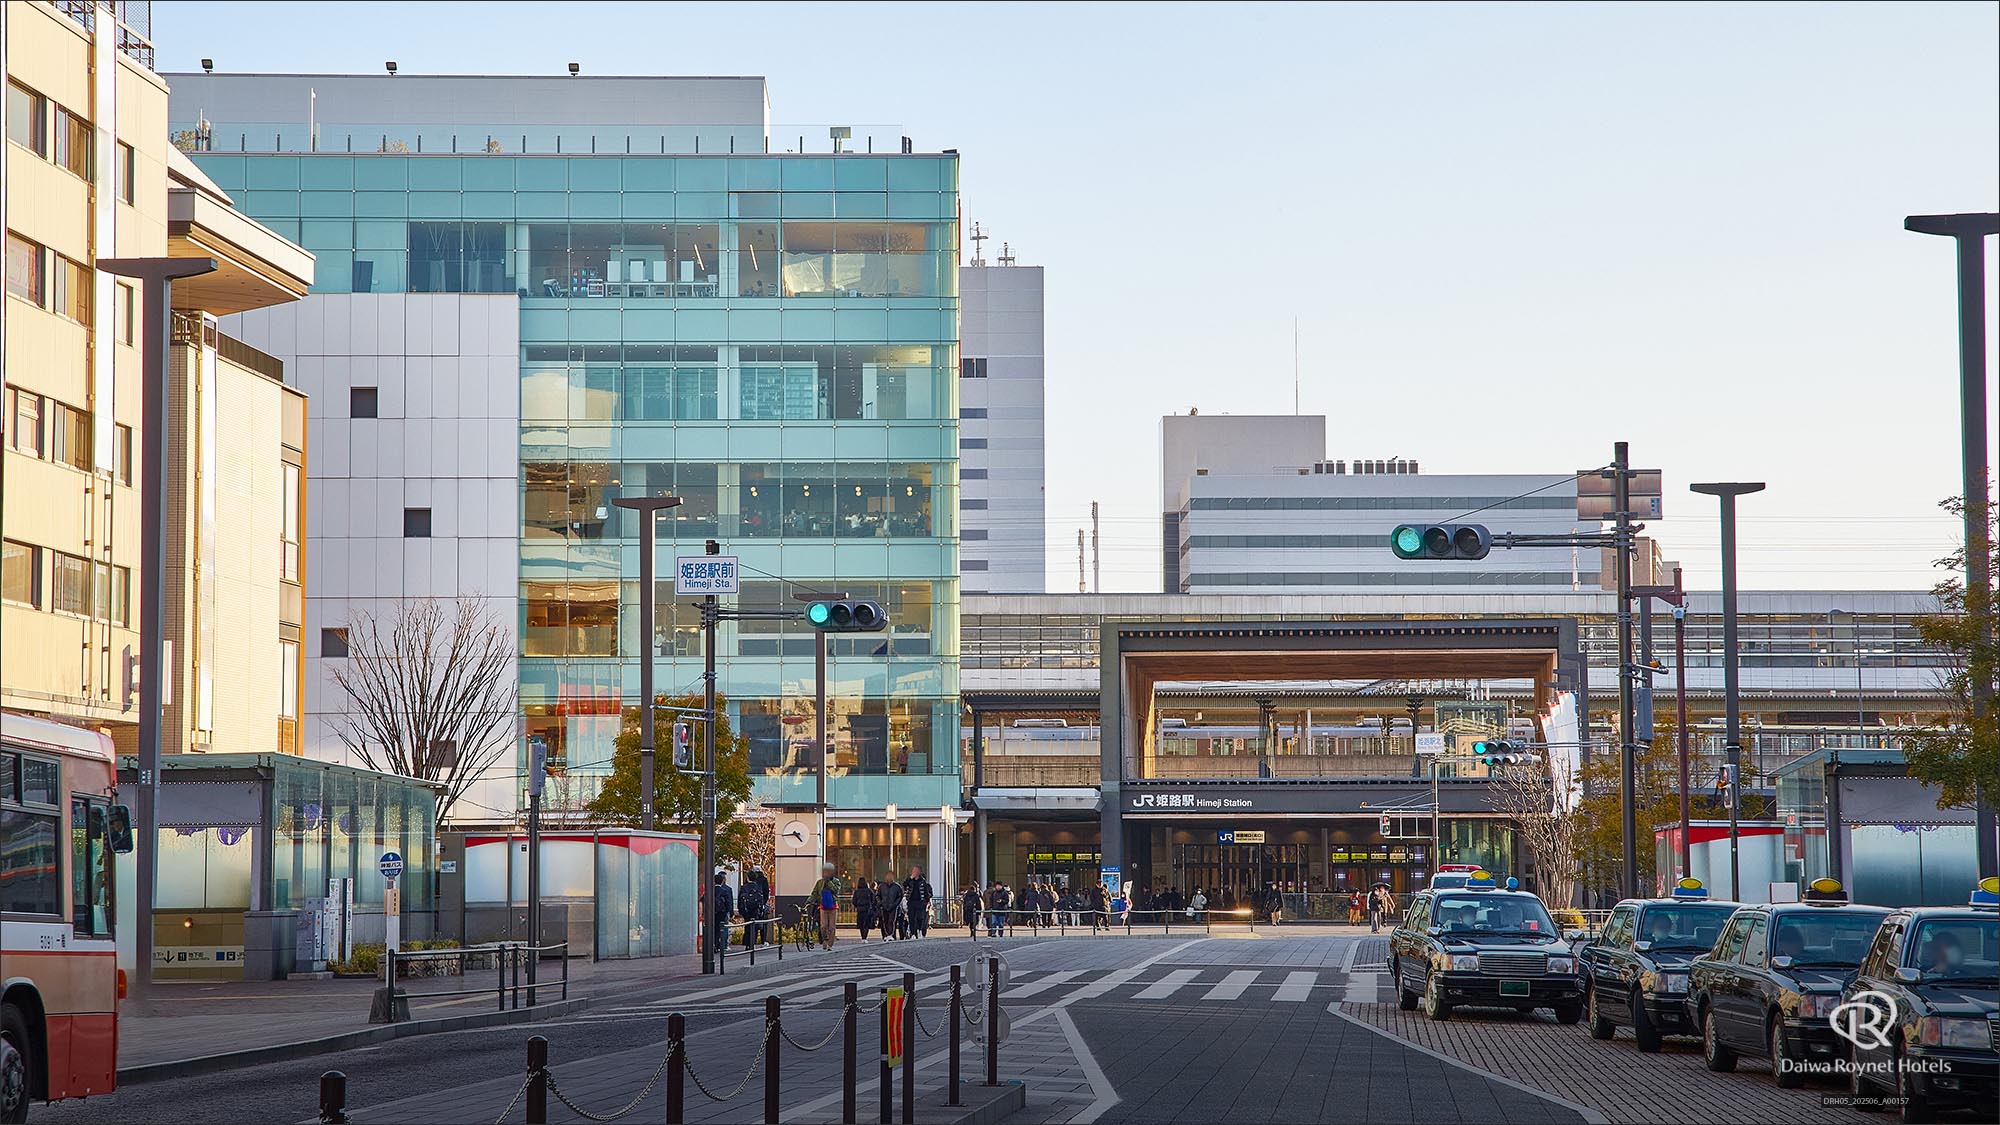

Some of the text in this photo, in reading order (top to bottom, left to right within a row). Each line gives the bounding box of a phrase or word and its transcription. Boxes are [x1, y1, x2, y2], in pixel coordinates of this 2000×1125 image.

[681, 562, 734, 579] 姫路駅前
[684, 578, 733, 589] Himeji Sta.
[1196, 798, 1253, 809] Himeji Station
[1219, 833, 1233, 841] JR
